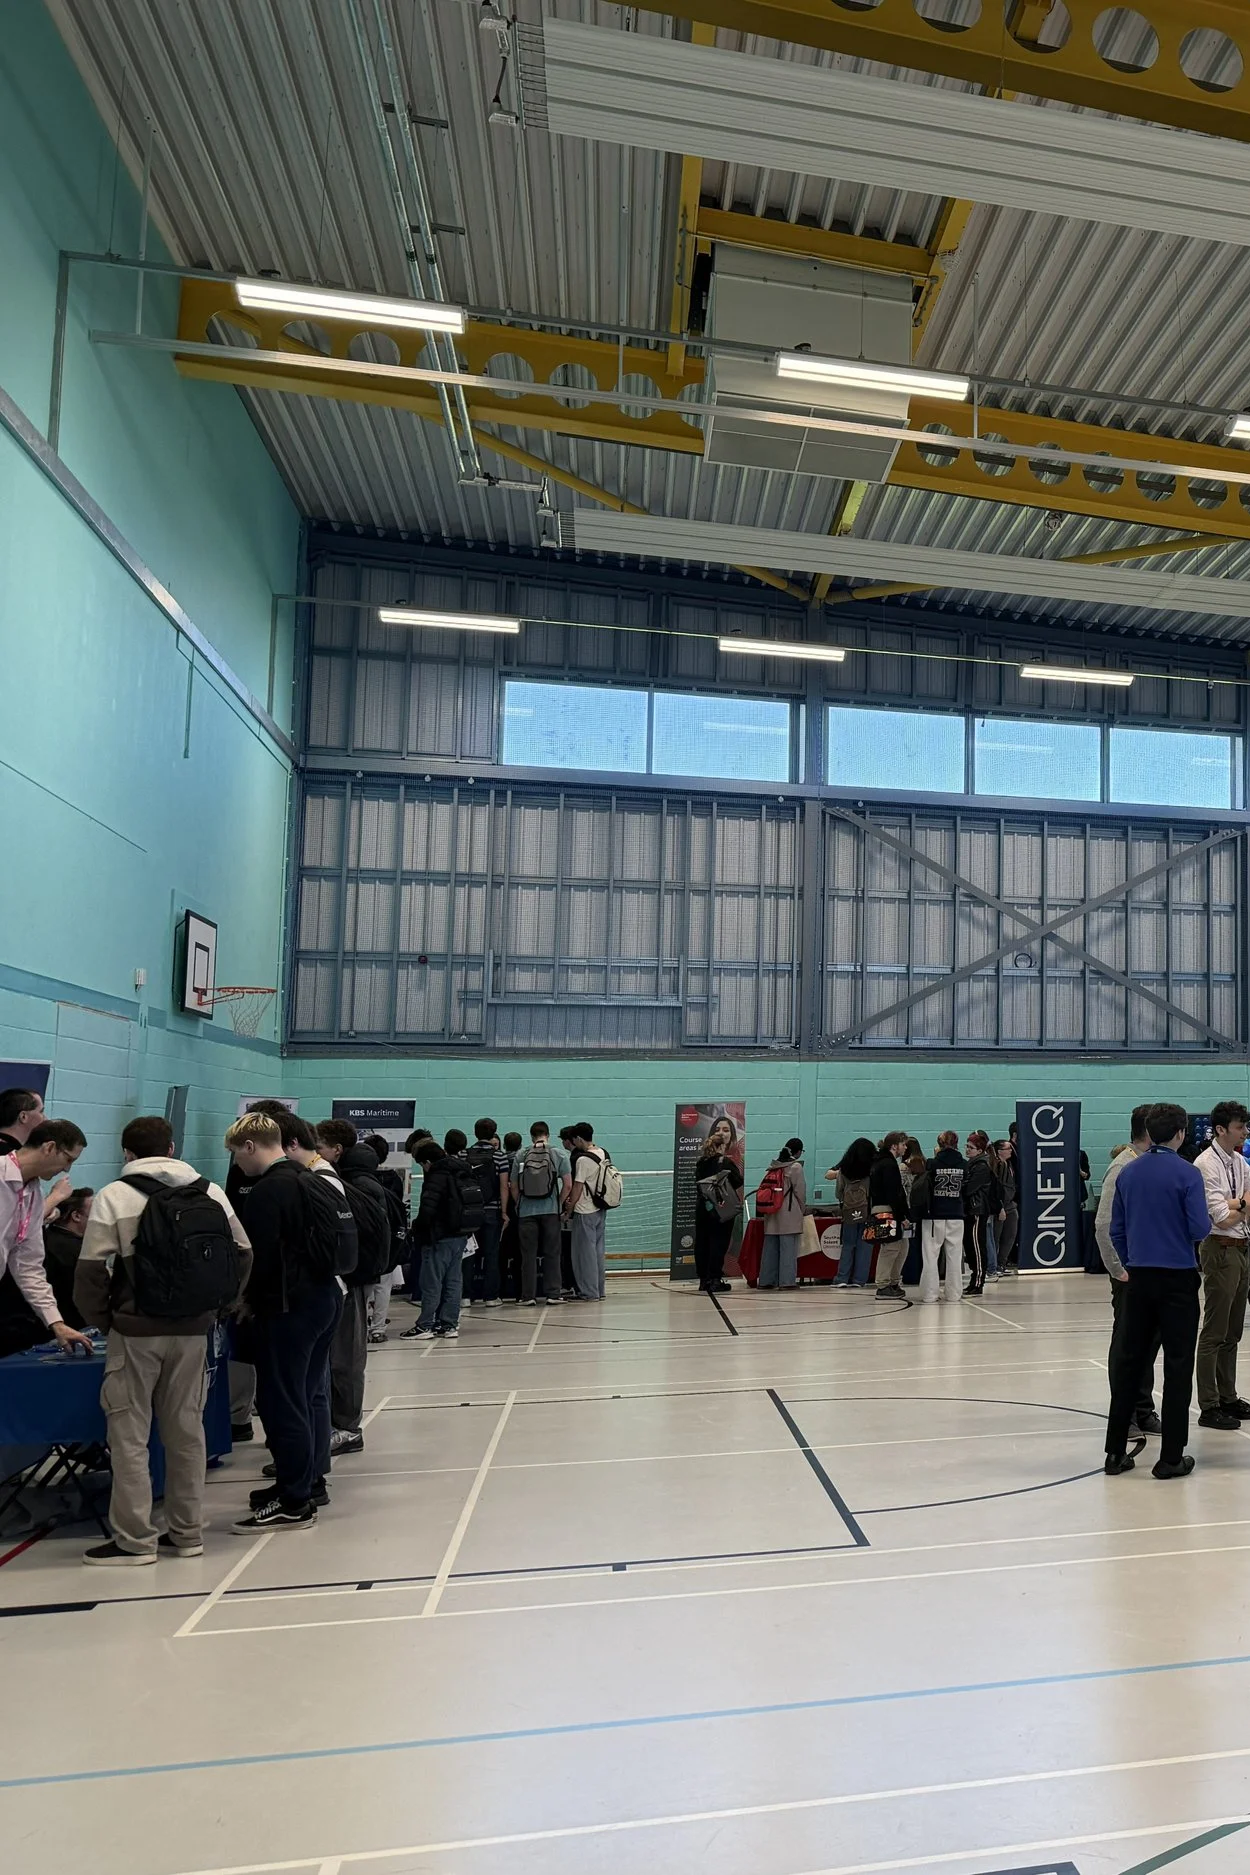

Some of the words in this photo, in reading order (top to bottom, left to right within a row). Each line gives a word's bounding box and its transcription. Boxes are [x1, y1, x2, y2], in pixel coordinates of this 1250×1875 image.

[366, 1109, 400, 1117] Maritime
[934, 1174, 964, 1192] 25
[1031, 1104, 1066, 1266] QINETIQ
